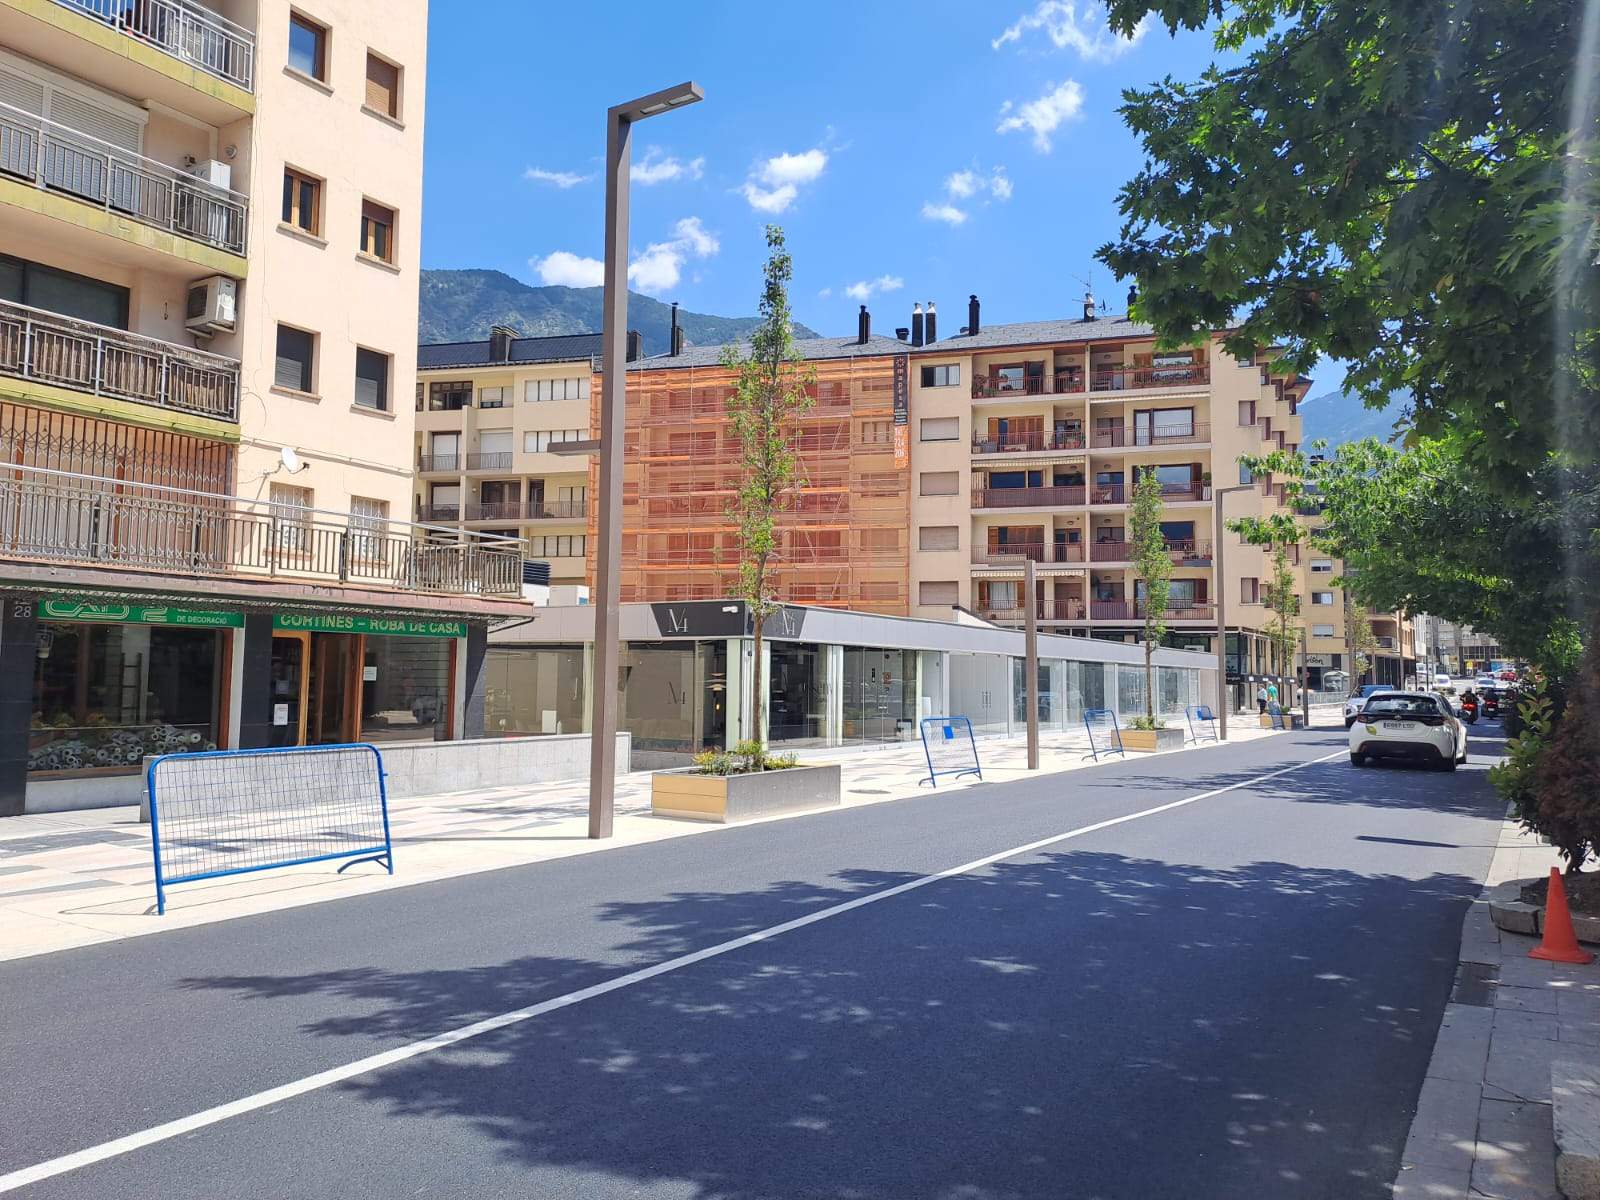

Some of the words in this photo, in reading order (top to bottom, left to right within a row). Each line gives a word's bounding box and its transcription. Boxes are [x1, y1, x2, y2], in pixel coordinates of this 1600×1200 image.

[14, 605, 32, 618] 28
[176, 615, 187, 623] DE
[280, 614, 354, 629] CORTINES
[369, 618, 406, 632] ROBA
[409, 622, 426, 633] DE
[429, 622, 461, 634] CASA
